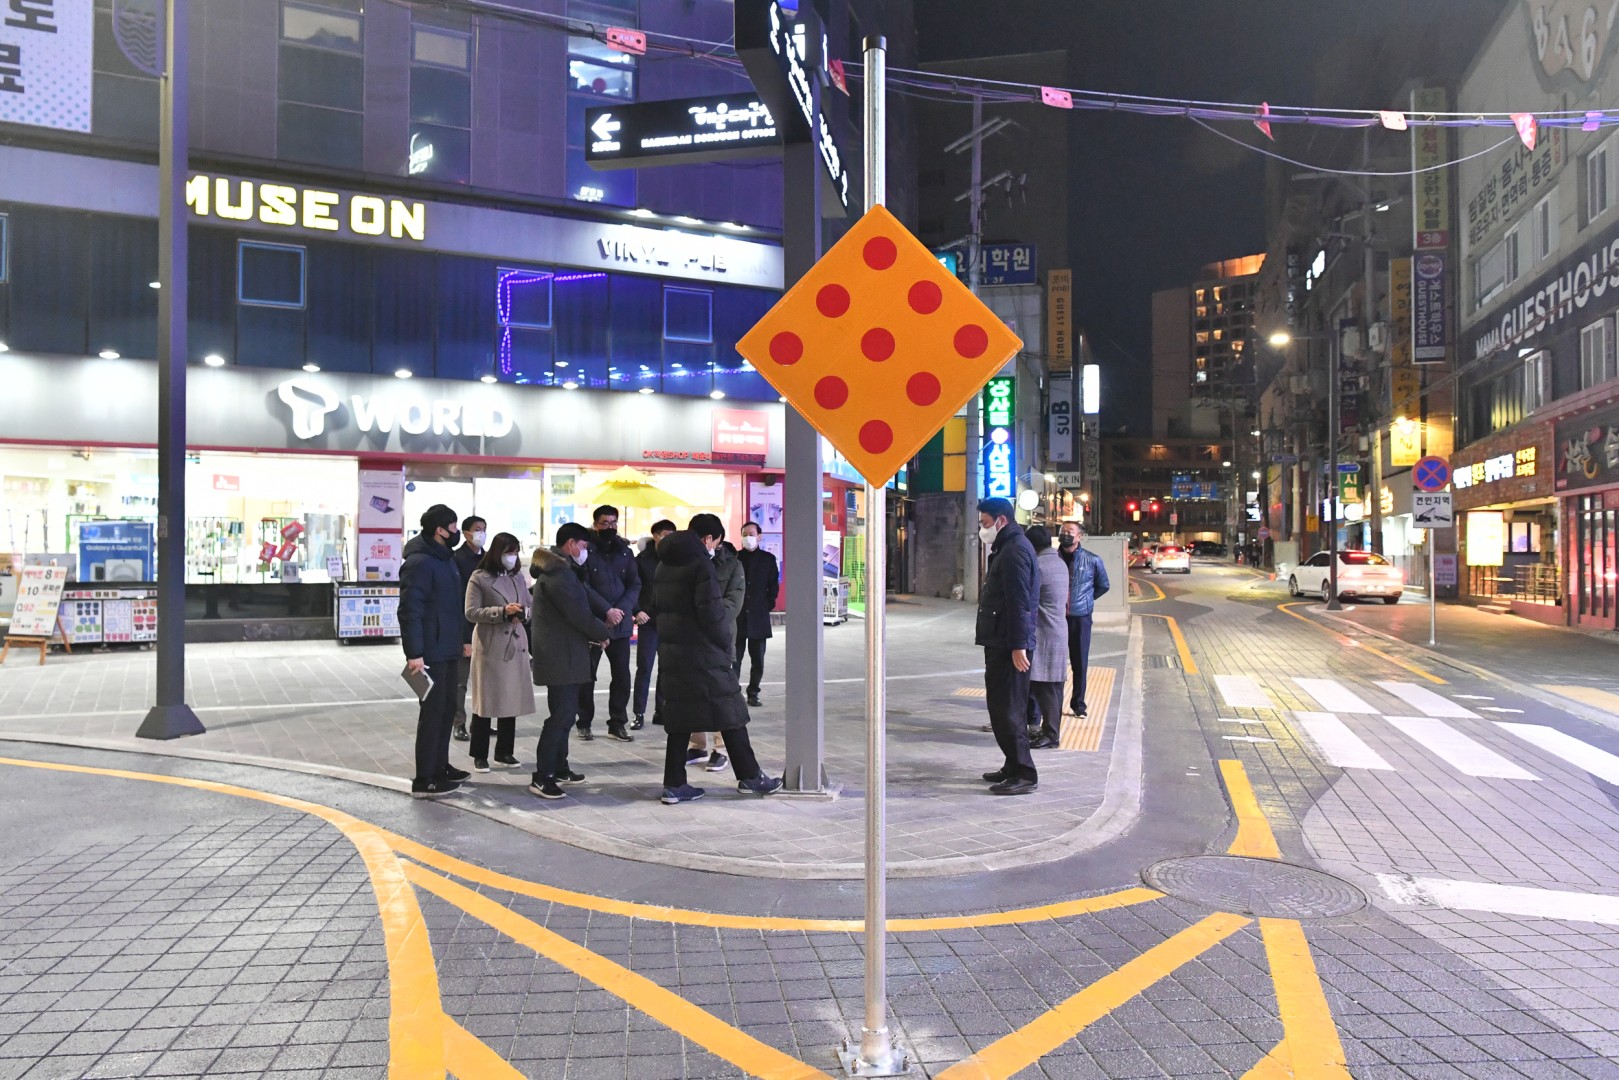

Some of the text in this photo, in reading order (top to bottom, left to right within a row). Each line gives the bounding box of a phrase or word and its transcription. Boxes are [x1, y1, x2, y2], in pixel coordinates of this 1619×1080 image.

[186, 174, 425, 241] MUSE ON
[1055, 297, 1066, 361] GUEST HOUSE
[1416, 280, 1428, 346] GUESTHOUSE
[1429, 278, 1442, 345] 게스트하우스
[1475, 326, 1501, 359] MAMA
[351, 393, 514, 439] WORLD
[1051, 399, 1071, 436] SUB
[1057, 474, 1080, 485] CK IN
[1415, 496, 1451, 507] 견인지역
[86, 544, 111, 552] Galaxy
[116, 544, 148, 552] Quantum
[27, 586, 39, 597] 10
[45, 569, 53, 580] 8
